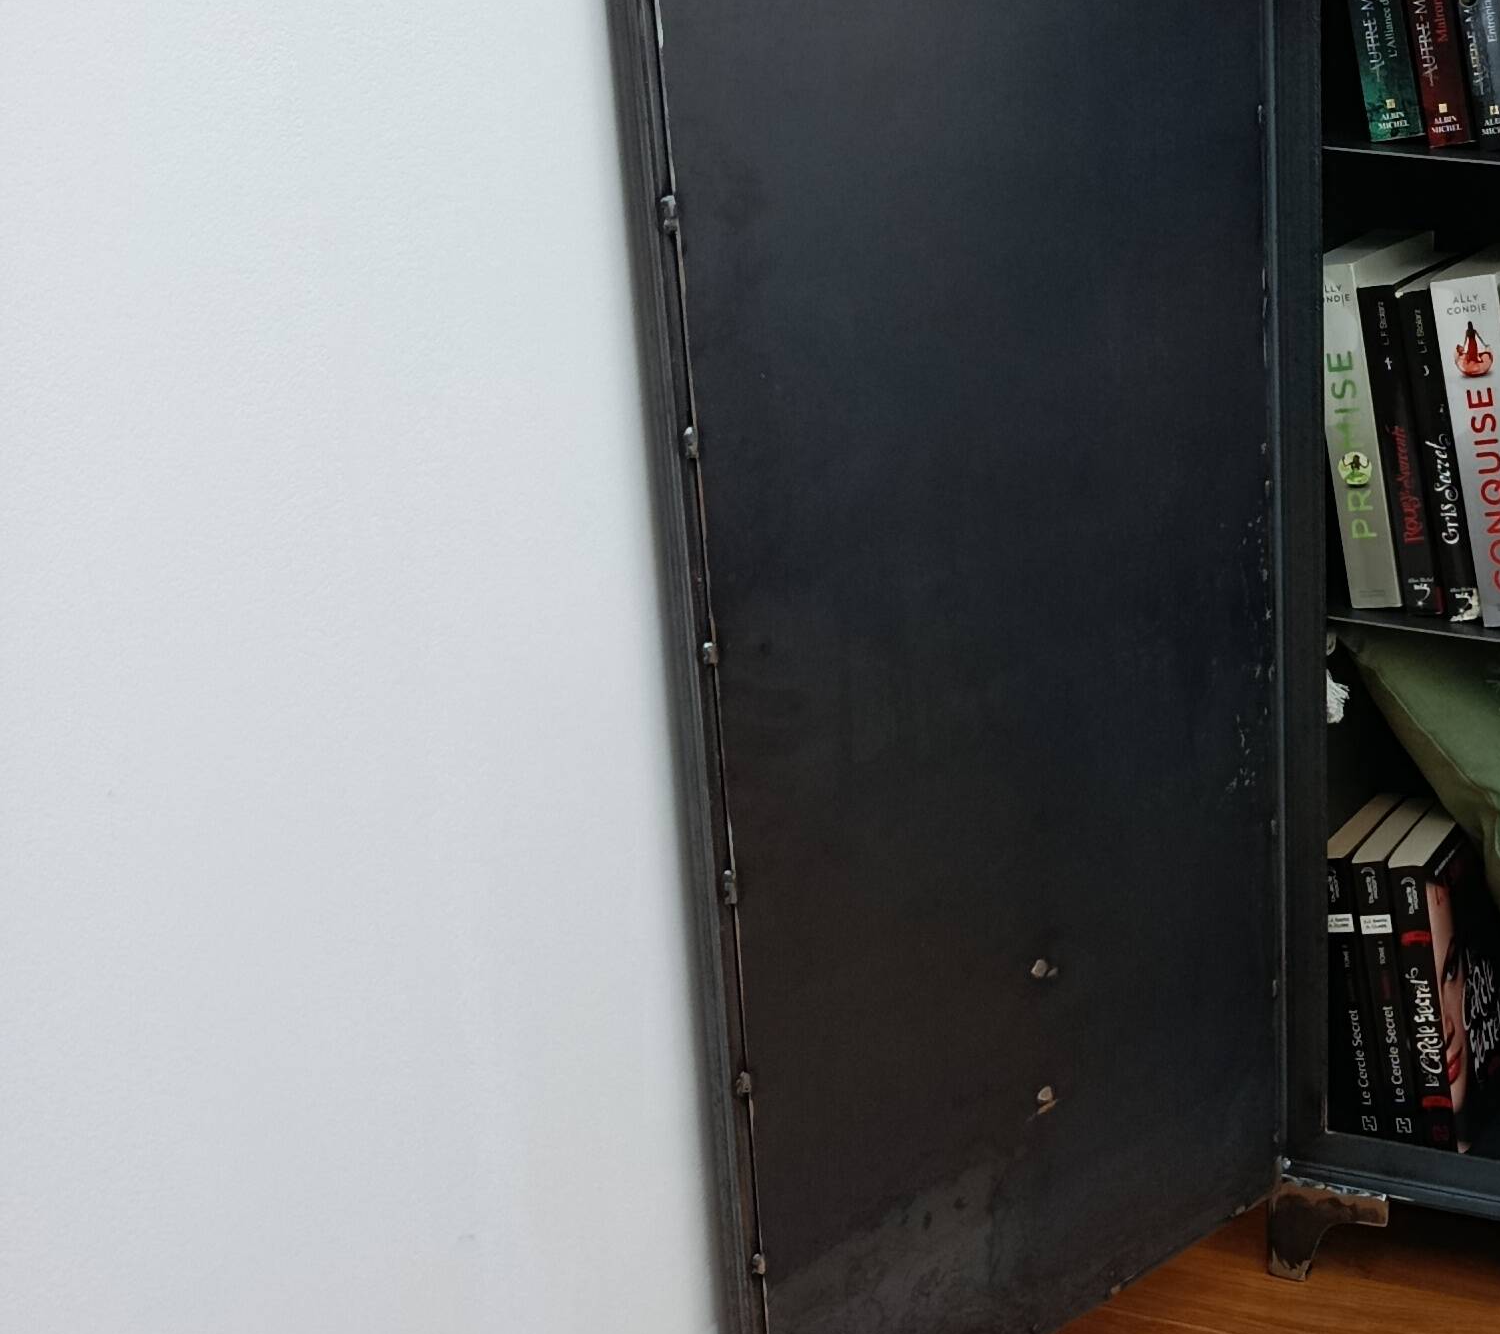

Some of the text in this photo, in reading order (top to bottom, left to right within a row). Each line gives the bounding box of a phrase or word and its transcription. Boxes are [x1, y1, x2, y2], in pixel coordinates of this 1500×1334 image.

[1324, 283, 1342, 293] LLY
[1452, 293, 1479, 303] ALLY
[1446, 303, 1487, 315] CONDIE
[1348, 1009, 1363, 1047] Secret
[1382, 1005, 1397, 1044] Secret
[1354, 1049, 1370, 1088] Cercle
[1388, 1046, 1403, 1085] Cercle
[1361, 1090, 1372, 1105] Le
[1394, 1087, 1406, 1102] Le
